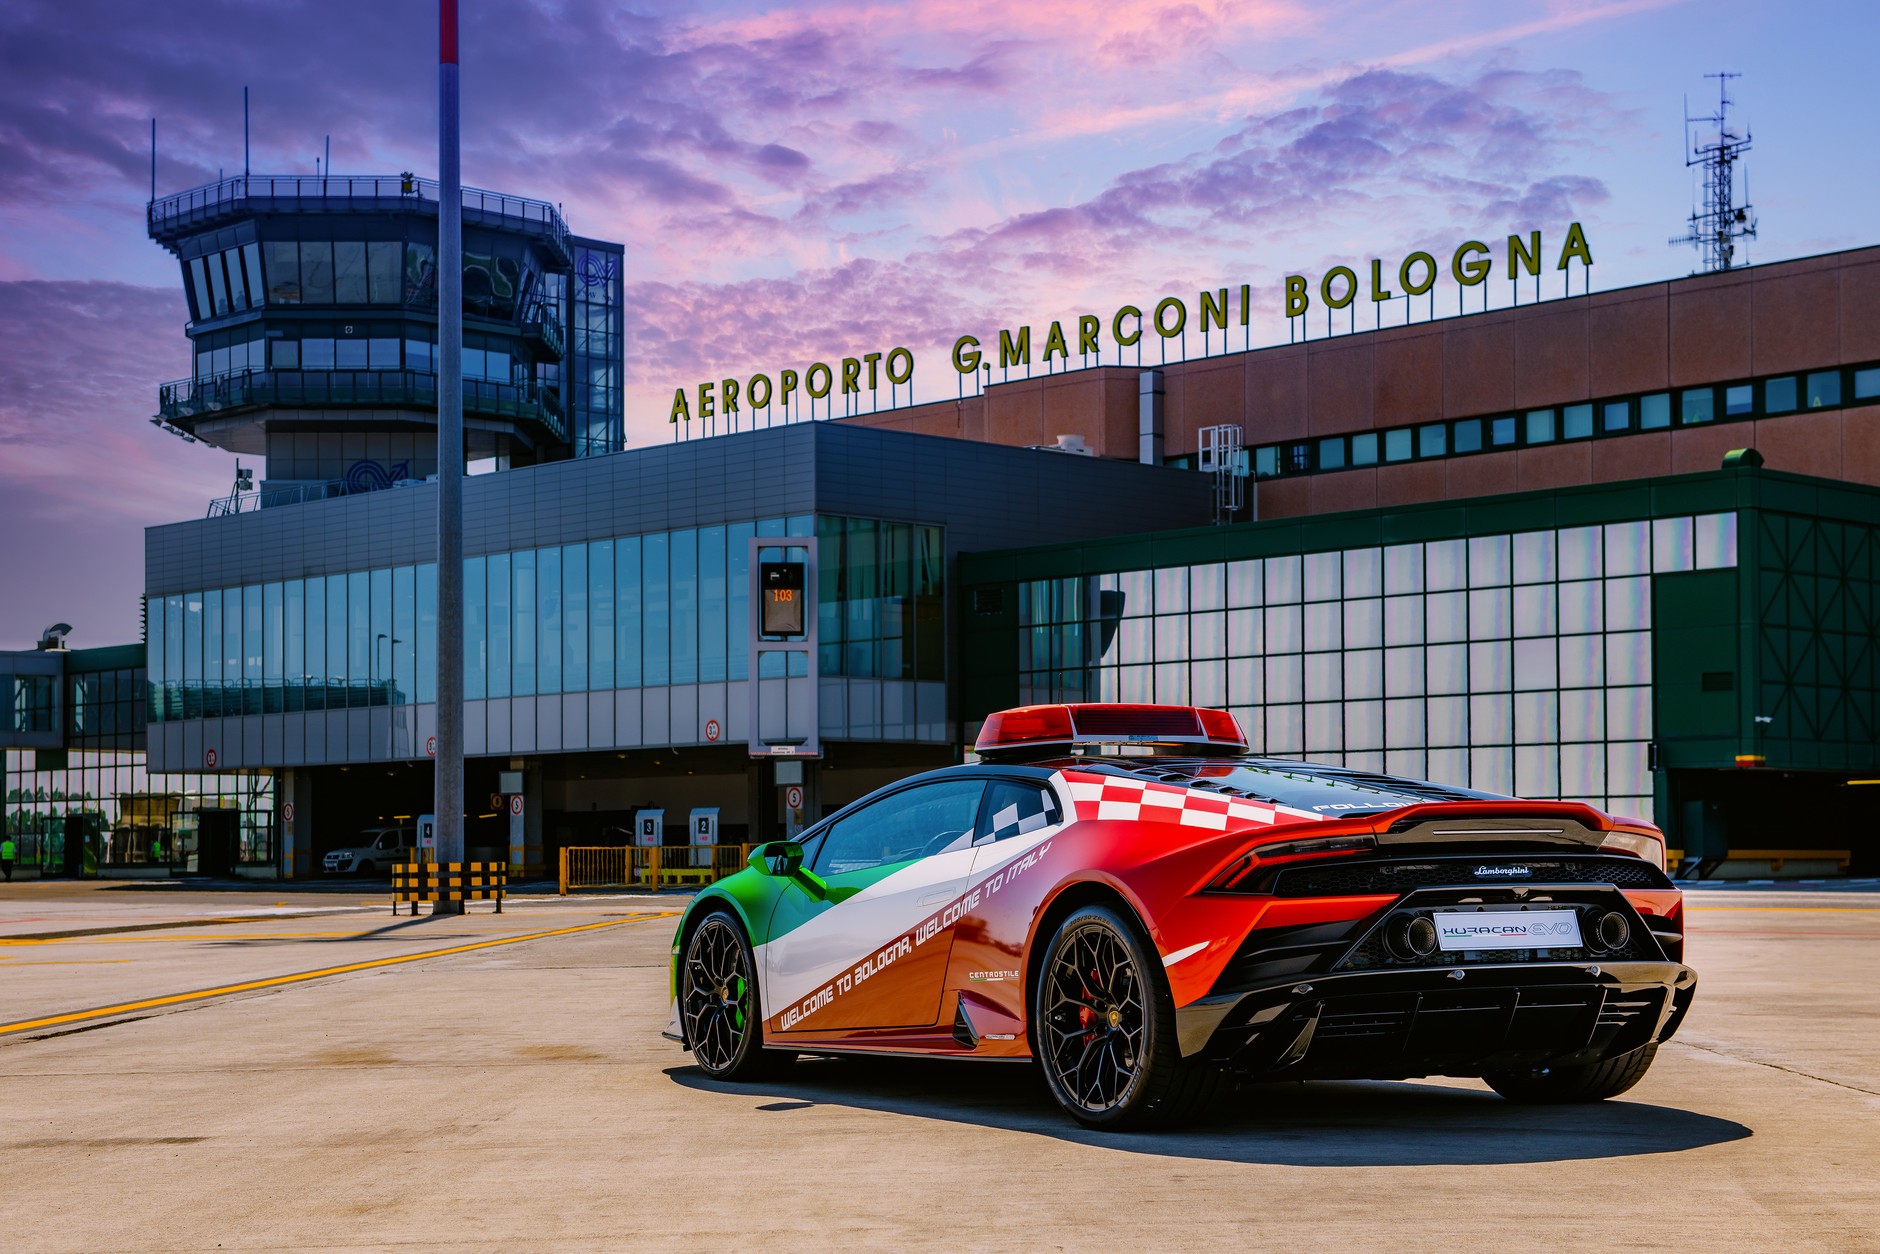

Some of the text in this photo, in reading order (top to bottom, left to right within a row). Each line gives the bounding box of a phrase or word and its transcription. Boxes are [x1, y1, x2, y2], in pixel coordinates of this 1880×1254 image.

[669, 347, 914, 424] AEROPORTO
[1285, 222, 1593, 318] BOLOGNA
[774, 589, 793, 602] 103
[792, 793, 797, 803] 5
[515, 800, 519, 810] 5
[1312, 802, 1414, 812] FOLLO
[426, 826, 431, 836] 4
[646, 822, 652, 833] 3
[701, 820, 707, 831] 2
[1474, 865, 1529, 876] Lamborghini
[1527, 922, 1573, 936] EVO
[781, 841, 1052, 1031] WELCOME TO BOLOGNA, WELCOME TO ITALY
[969, 970, 1019, 979] CENTROSTILE
